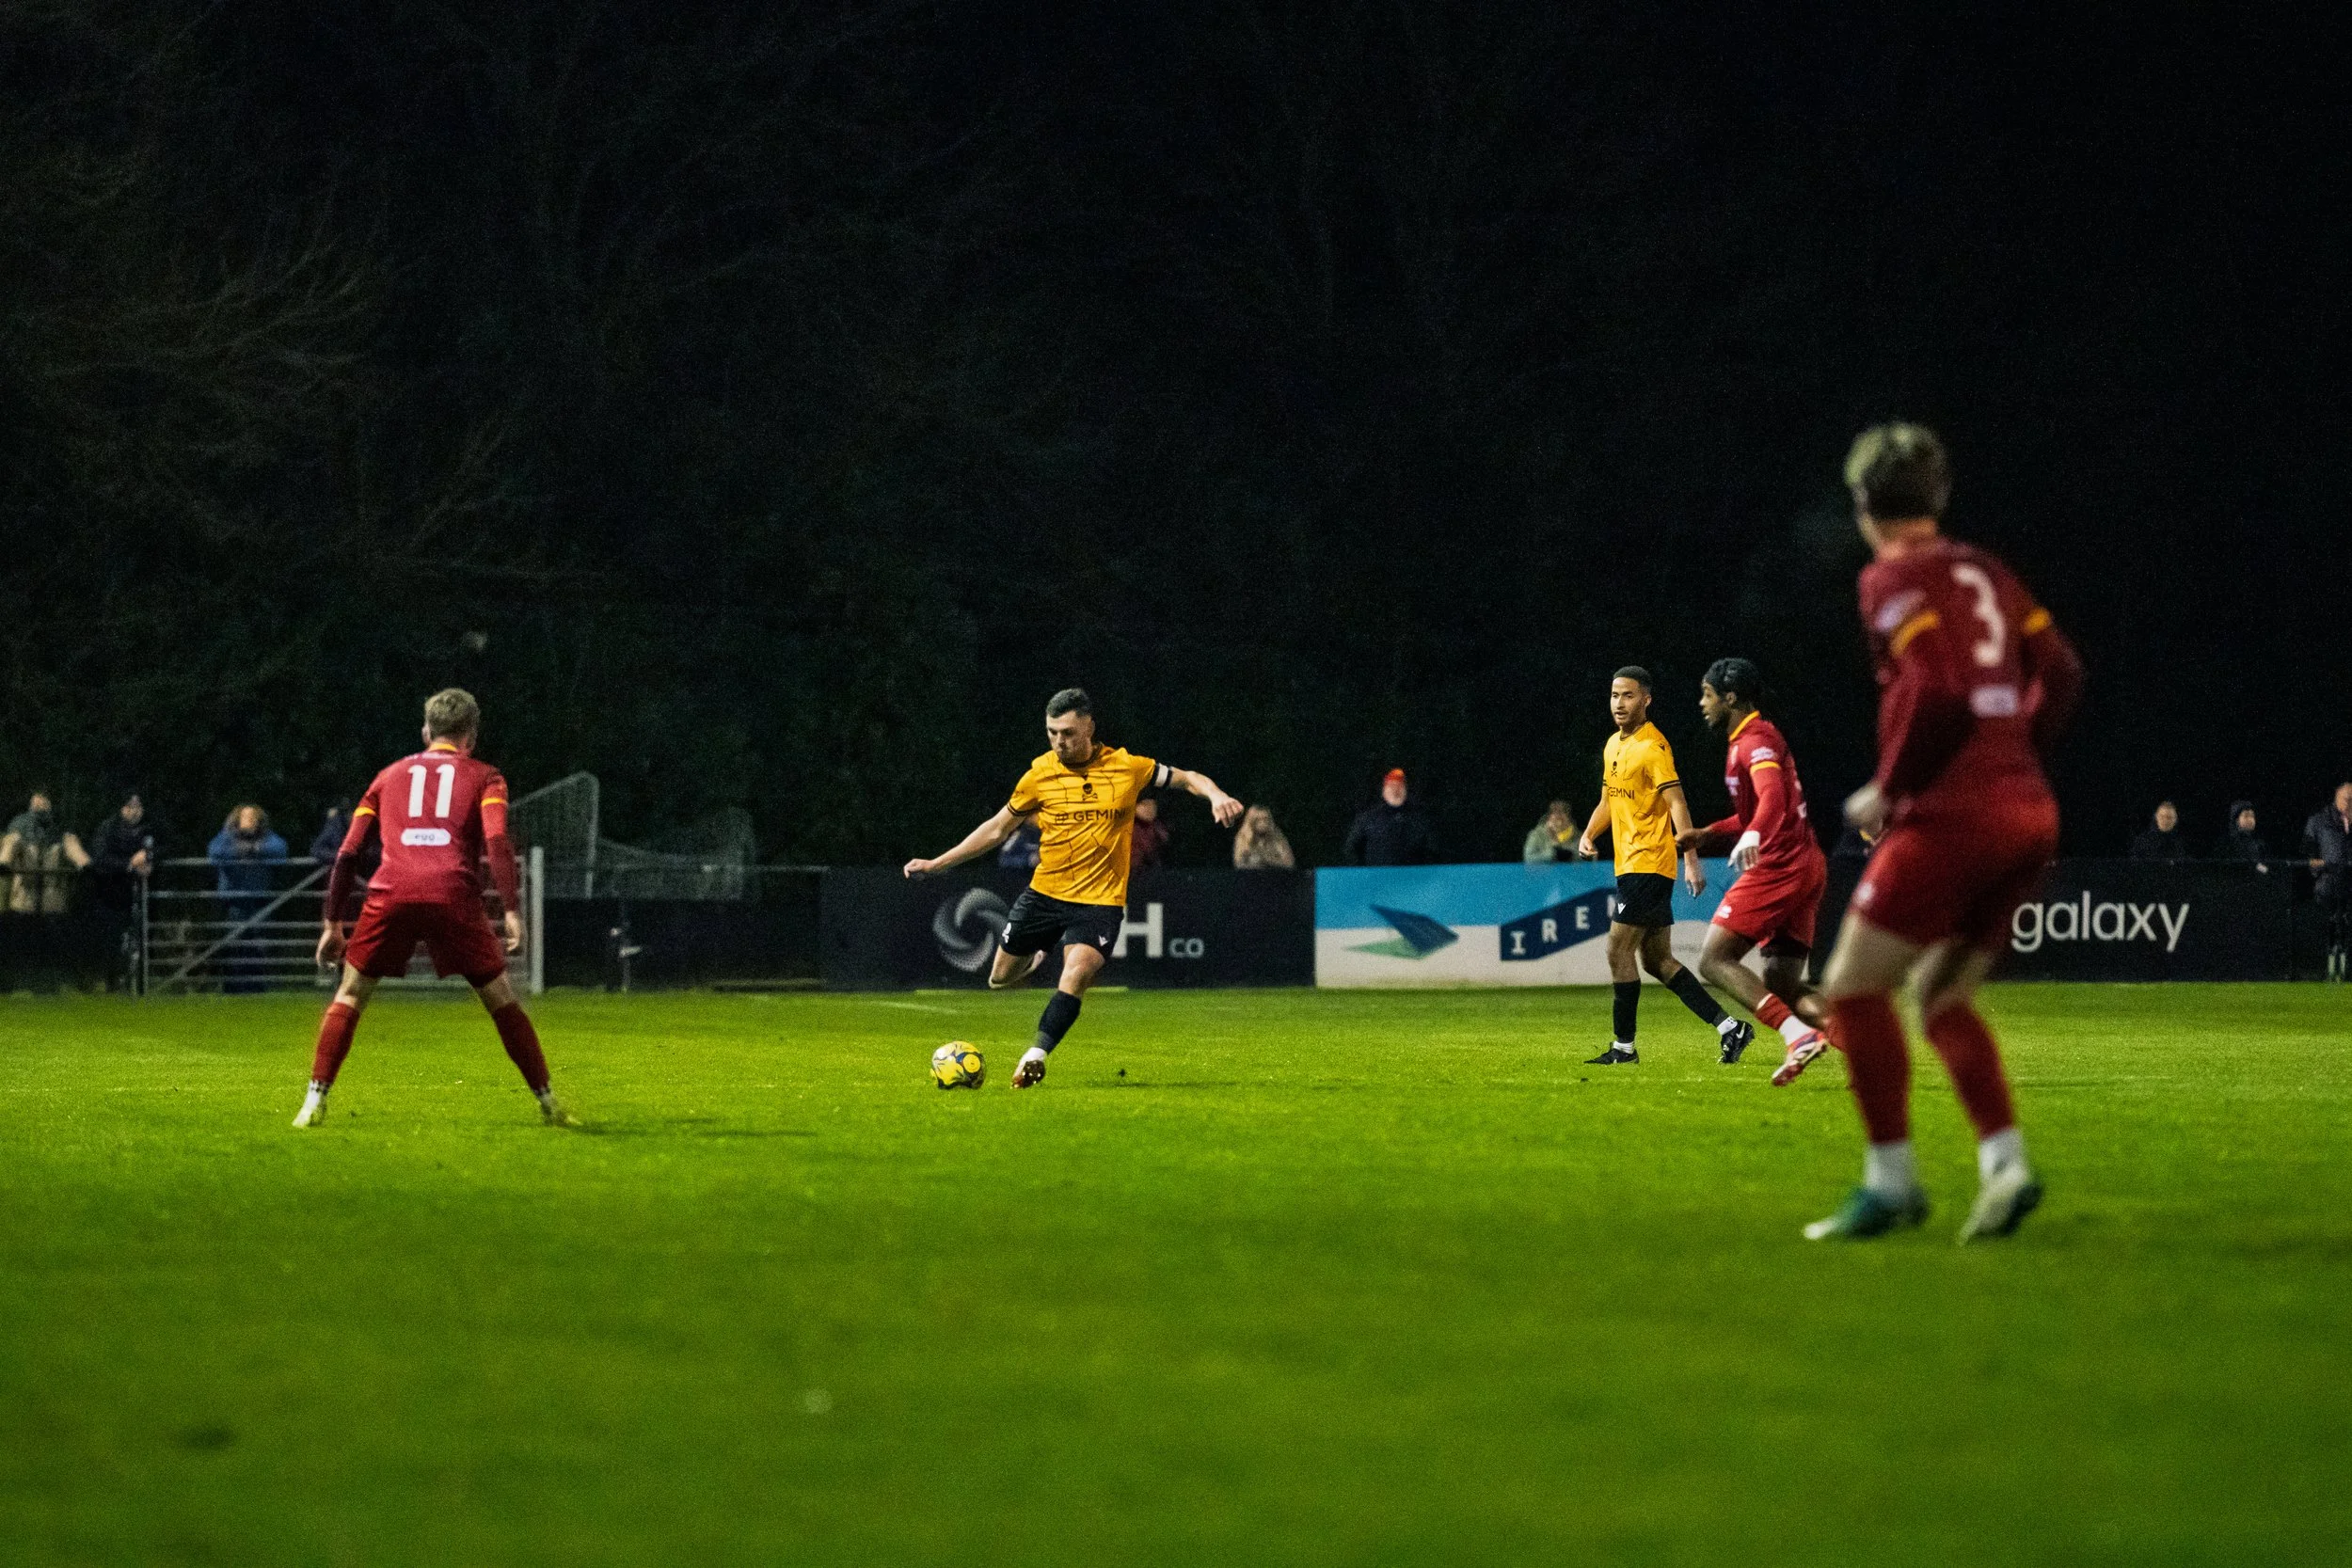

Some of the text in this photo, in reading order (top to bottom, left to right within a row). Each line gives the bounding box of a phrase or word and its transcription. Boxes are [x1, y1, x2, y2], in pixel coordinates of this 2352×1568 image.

[1950, 565, 2006, 667] 3
[407, 764, 455, 818] 11
[1169, 938, 1204, 958] co
[2011, 890, 2190, 953] galaxy
